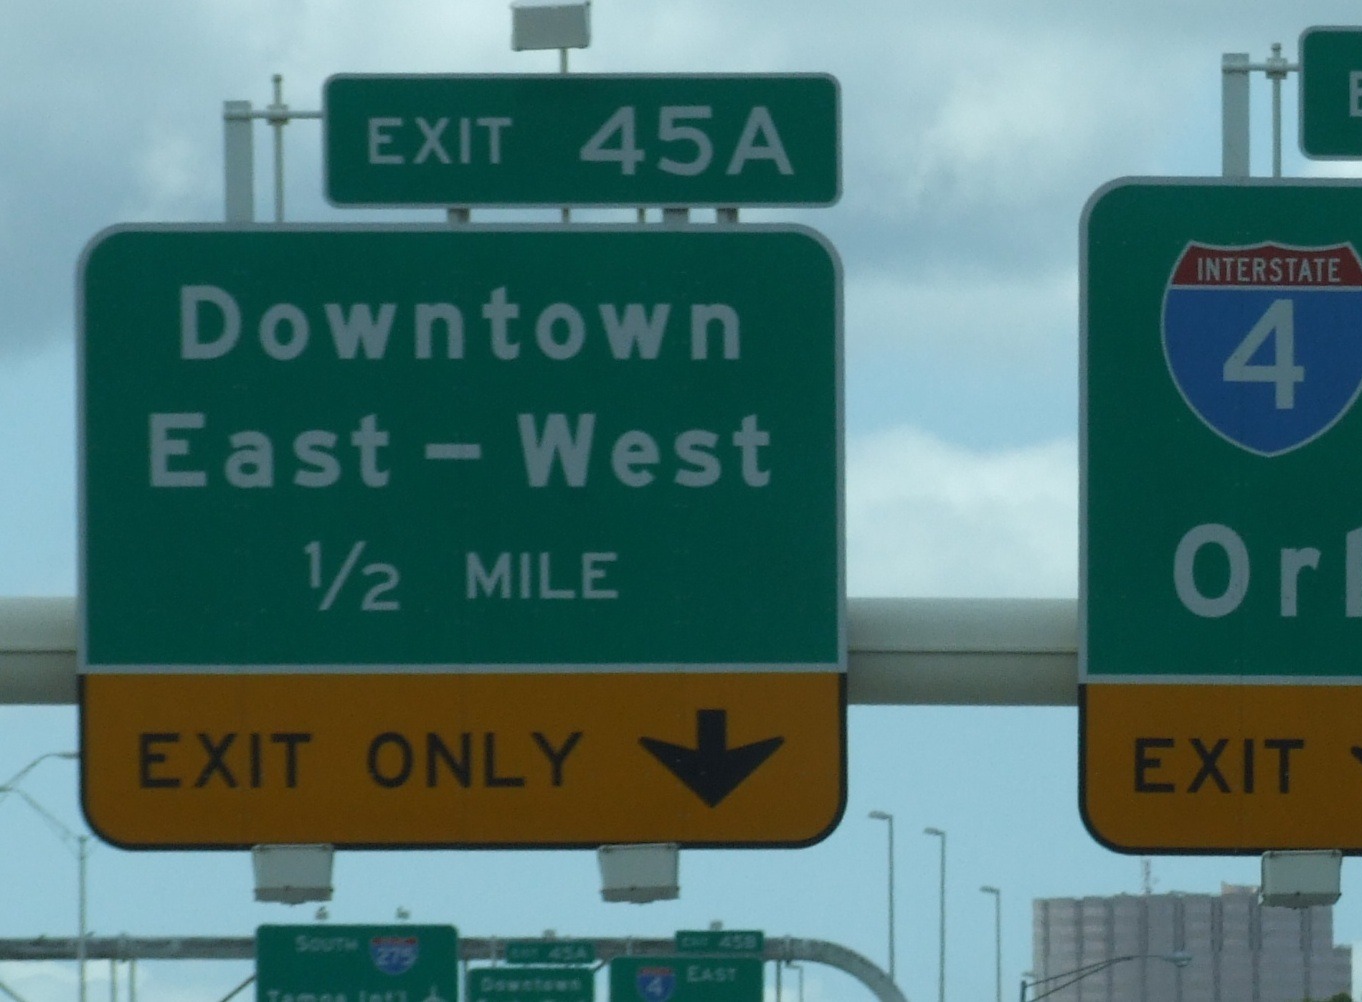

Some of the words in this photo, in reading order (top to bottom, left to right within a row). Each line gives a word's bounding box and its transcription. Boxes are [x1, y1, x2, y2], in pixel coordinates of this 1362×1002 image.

[367, 116, 513, 166] EXIT
[579, 104, 796, 178] 45A
[1196, 257, 1341, 285] INTERSTATE
[179, 284, 741, 361] Downtown
[1222, 298, 1305, 410] 4
[465, 551, 619, 600] MILE
[138, 732, 313, 789] EXIT
[366, 731, 584, 789] ONLY
[1133, 737, 1305, 794] EXIT
[686, 964, 737, 983] EAST
